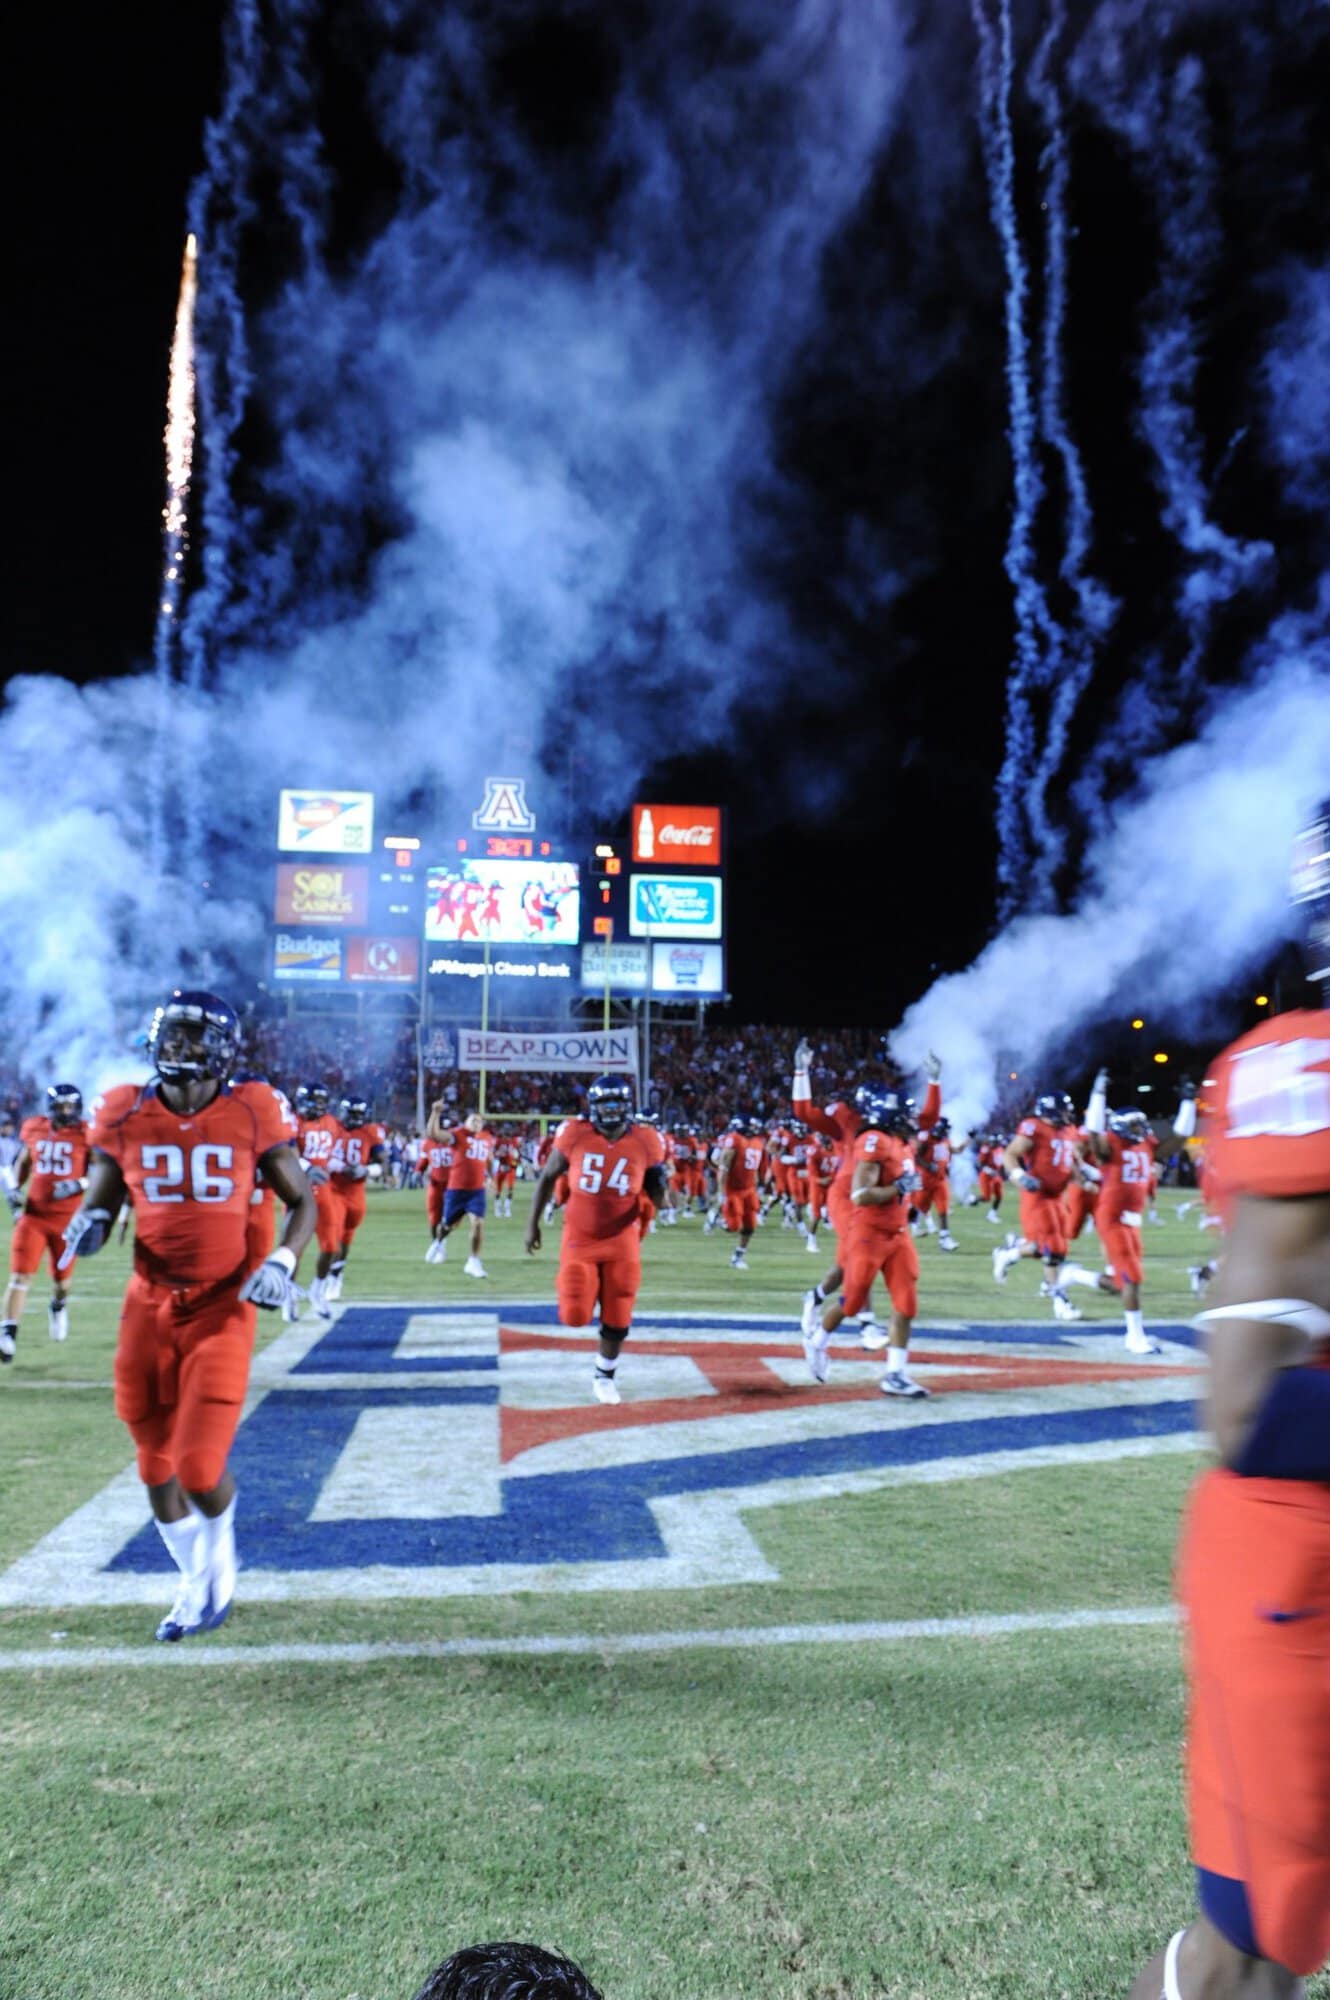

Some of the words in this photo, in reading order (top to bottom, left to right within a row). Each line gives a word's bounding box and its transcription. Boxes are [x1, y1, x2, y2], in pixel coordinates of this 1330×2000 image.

[472, 777, 536, 832] A
[293, 871, 344, 897] SOL
[276, 934, 341, 960] Budget
[36, 1140, 73, 1176] 35
[865, 1135, 878, 1152] 2
[141, 1144, 234, 1203] 26
[579, 1153, 630, 1197] 54
[1121, 1151, 1149, 1183] 21
